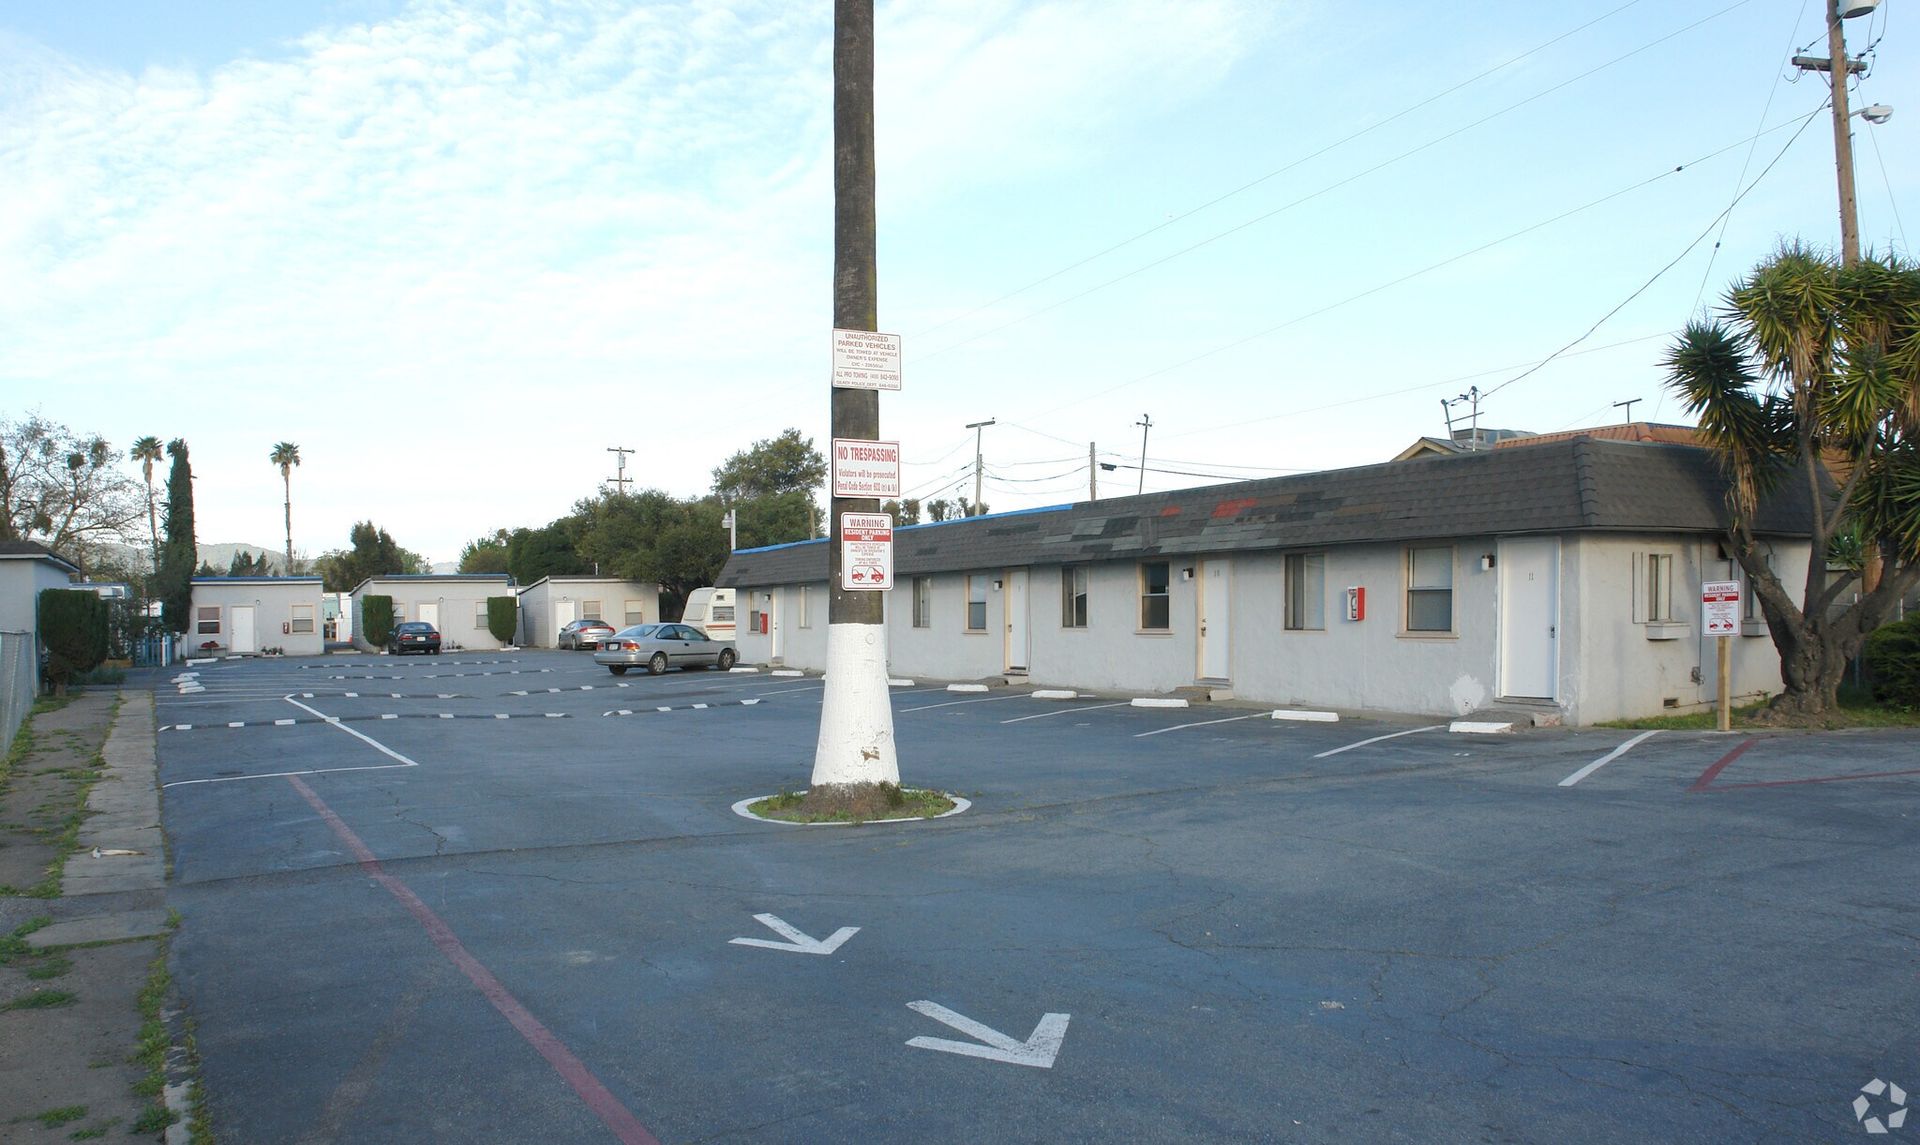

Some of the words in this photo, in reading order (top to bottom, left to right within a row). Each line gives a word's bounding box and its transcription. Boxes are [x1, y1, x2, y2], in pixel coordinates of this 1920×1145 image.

[845, 333, 889, 342] UNAUTHORIZED
[865, 342, 896, 350] VEHICLES
[838, 446, 848, 460] NO
[850, 447, 896, 462] TRESPASSING
[838, 468, 857, 478] Violators
[867, 470, 872, 478] be
[873, 471, 896, 479] prosecuted
[838, 481, 848, 490] Penal
[848, 481, 858, 490] Code
[859, 482, 872, 491] Section
[850, 519, 885, 528] WARNING
